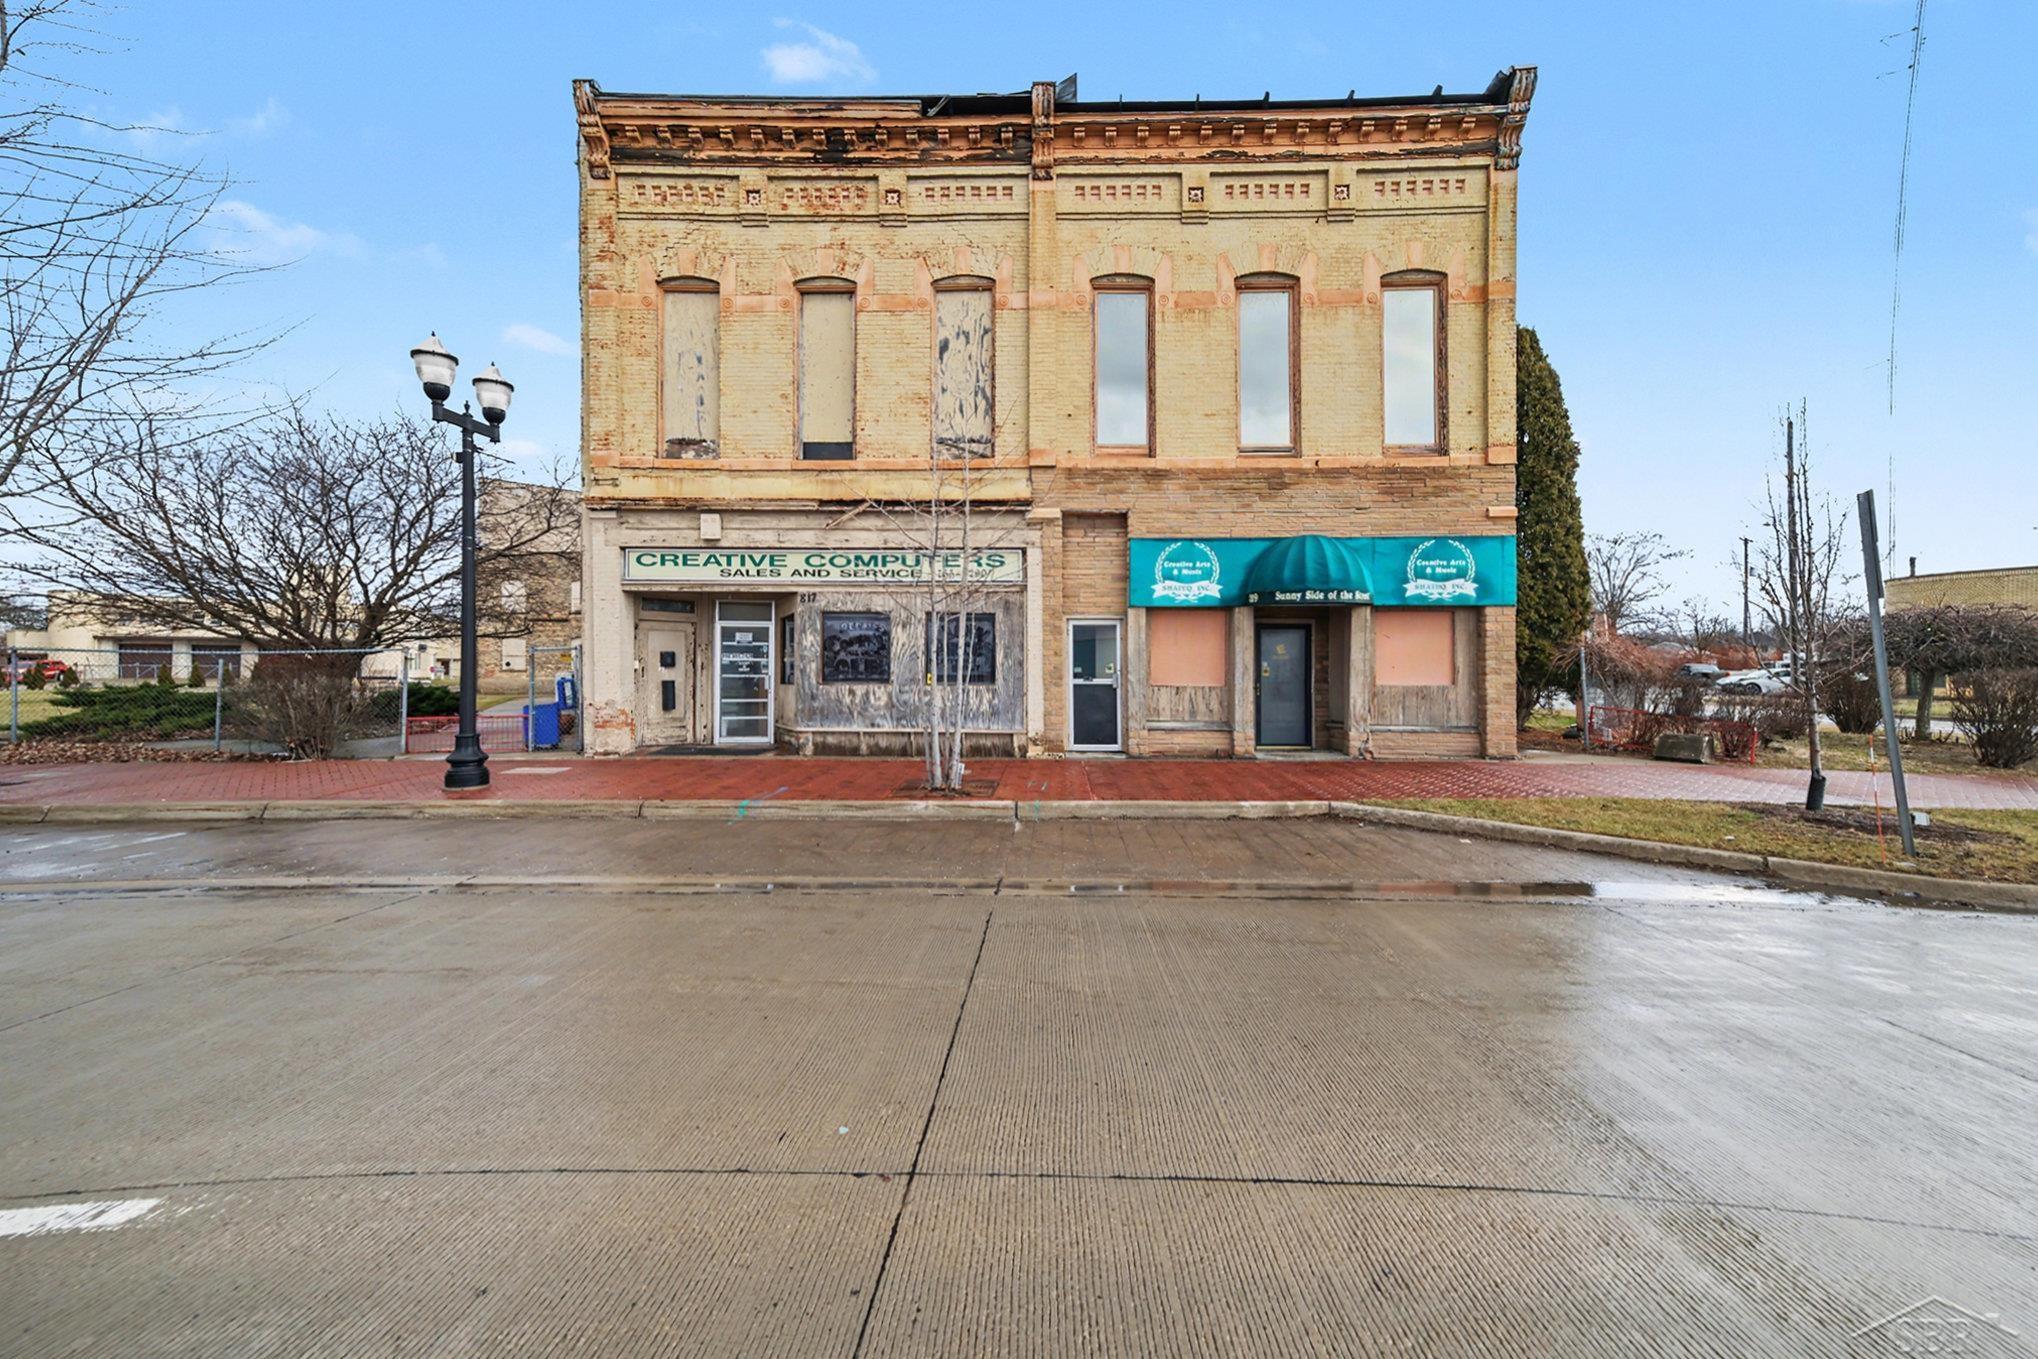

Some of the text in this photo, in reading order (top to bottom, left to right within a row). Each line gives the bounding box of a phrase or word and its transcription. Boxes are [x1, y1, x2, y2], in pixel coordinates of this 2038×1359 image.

[635, 553, 787, 567] CREATIVE
[719, 568, 922, 578] SALES AND SERVICE
[799, 592, 817, 603] 817
[1275, 591, 1302, 602] Sunny
[1305, 590, 1325, 600] Side
[1328, 590, 1338, 600] of
[1340, 590, 1353, 600] the
